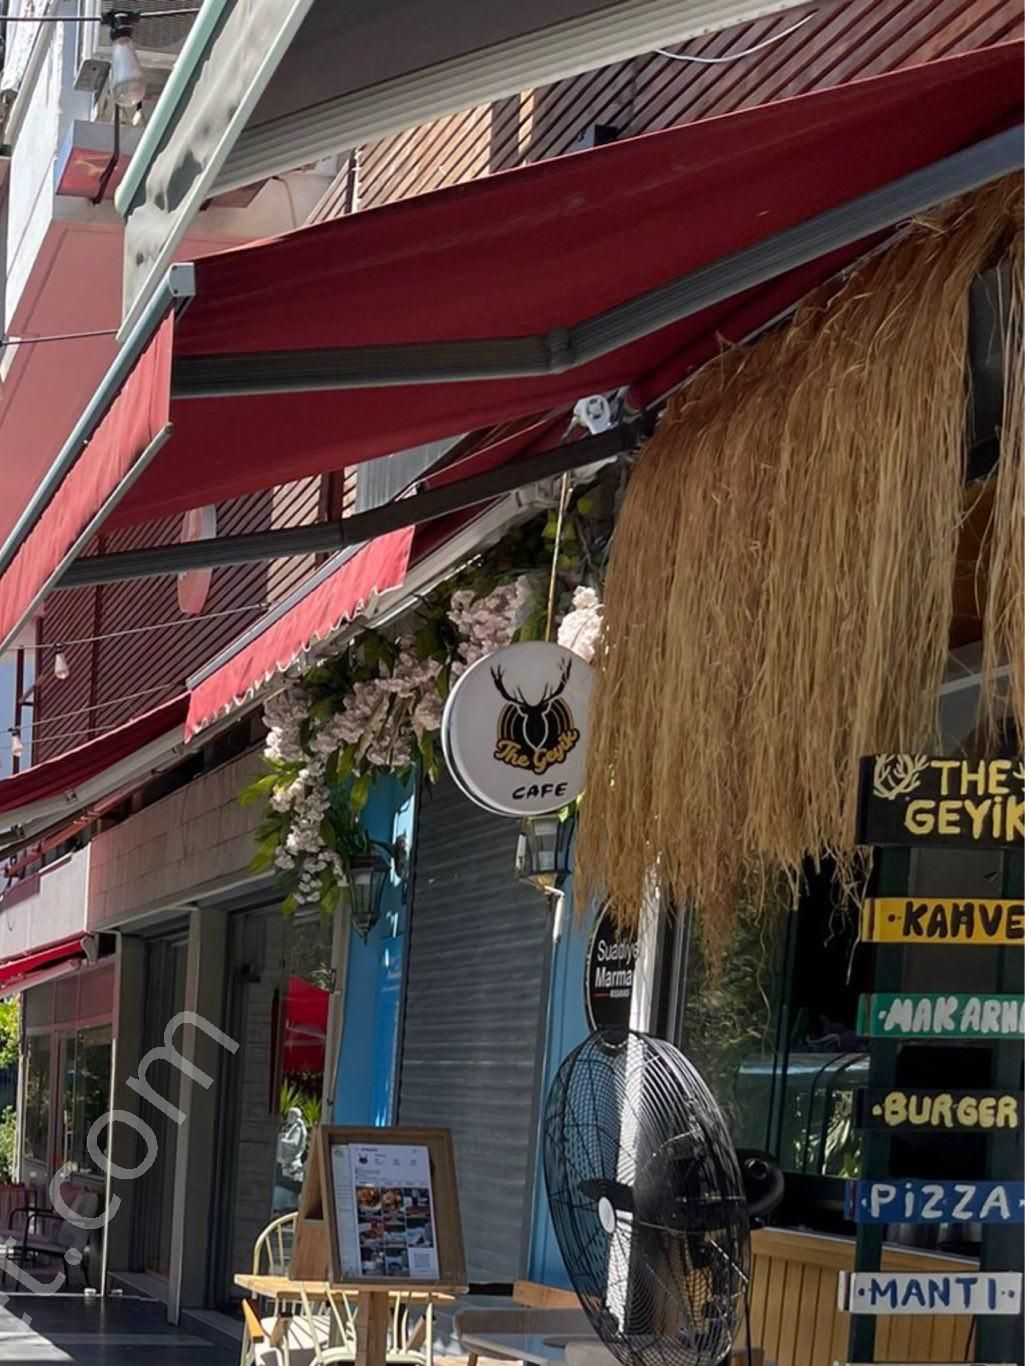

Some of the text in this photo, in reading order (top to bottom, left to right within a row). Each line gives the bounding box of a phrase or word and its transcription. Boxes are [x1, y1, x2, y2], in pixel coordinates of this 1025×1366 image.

[494, 729, 577, 774] The Geyik
[512, 782, 568, 800] CAFE
[930, 760, 1012, 796] THE
[902, 901, 1024, 939] KAHVE
[884, 1091, 1018, 1129] BURGER
[870, 1277, 997, 1309] MANTI
